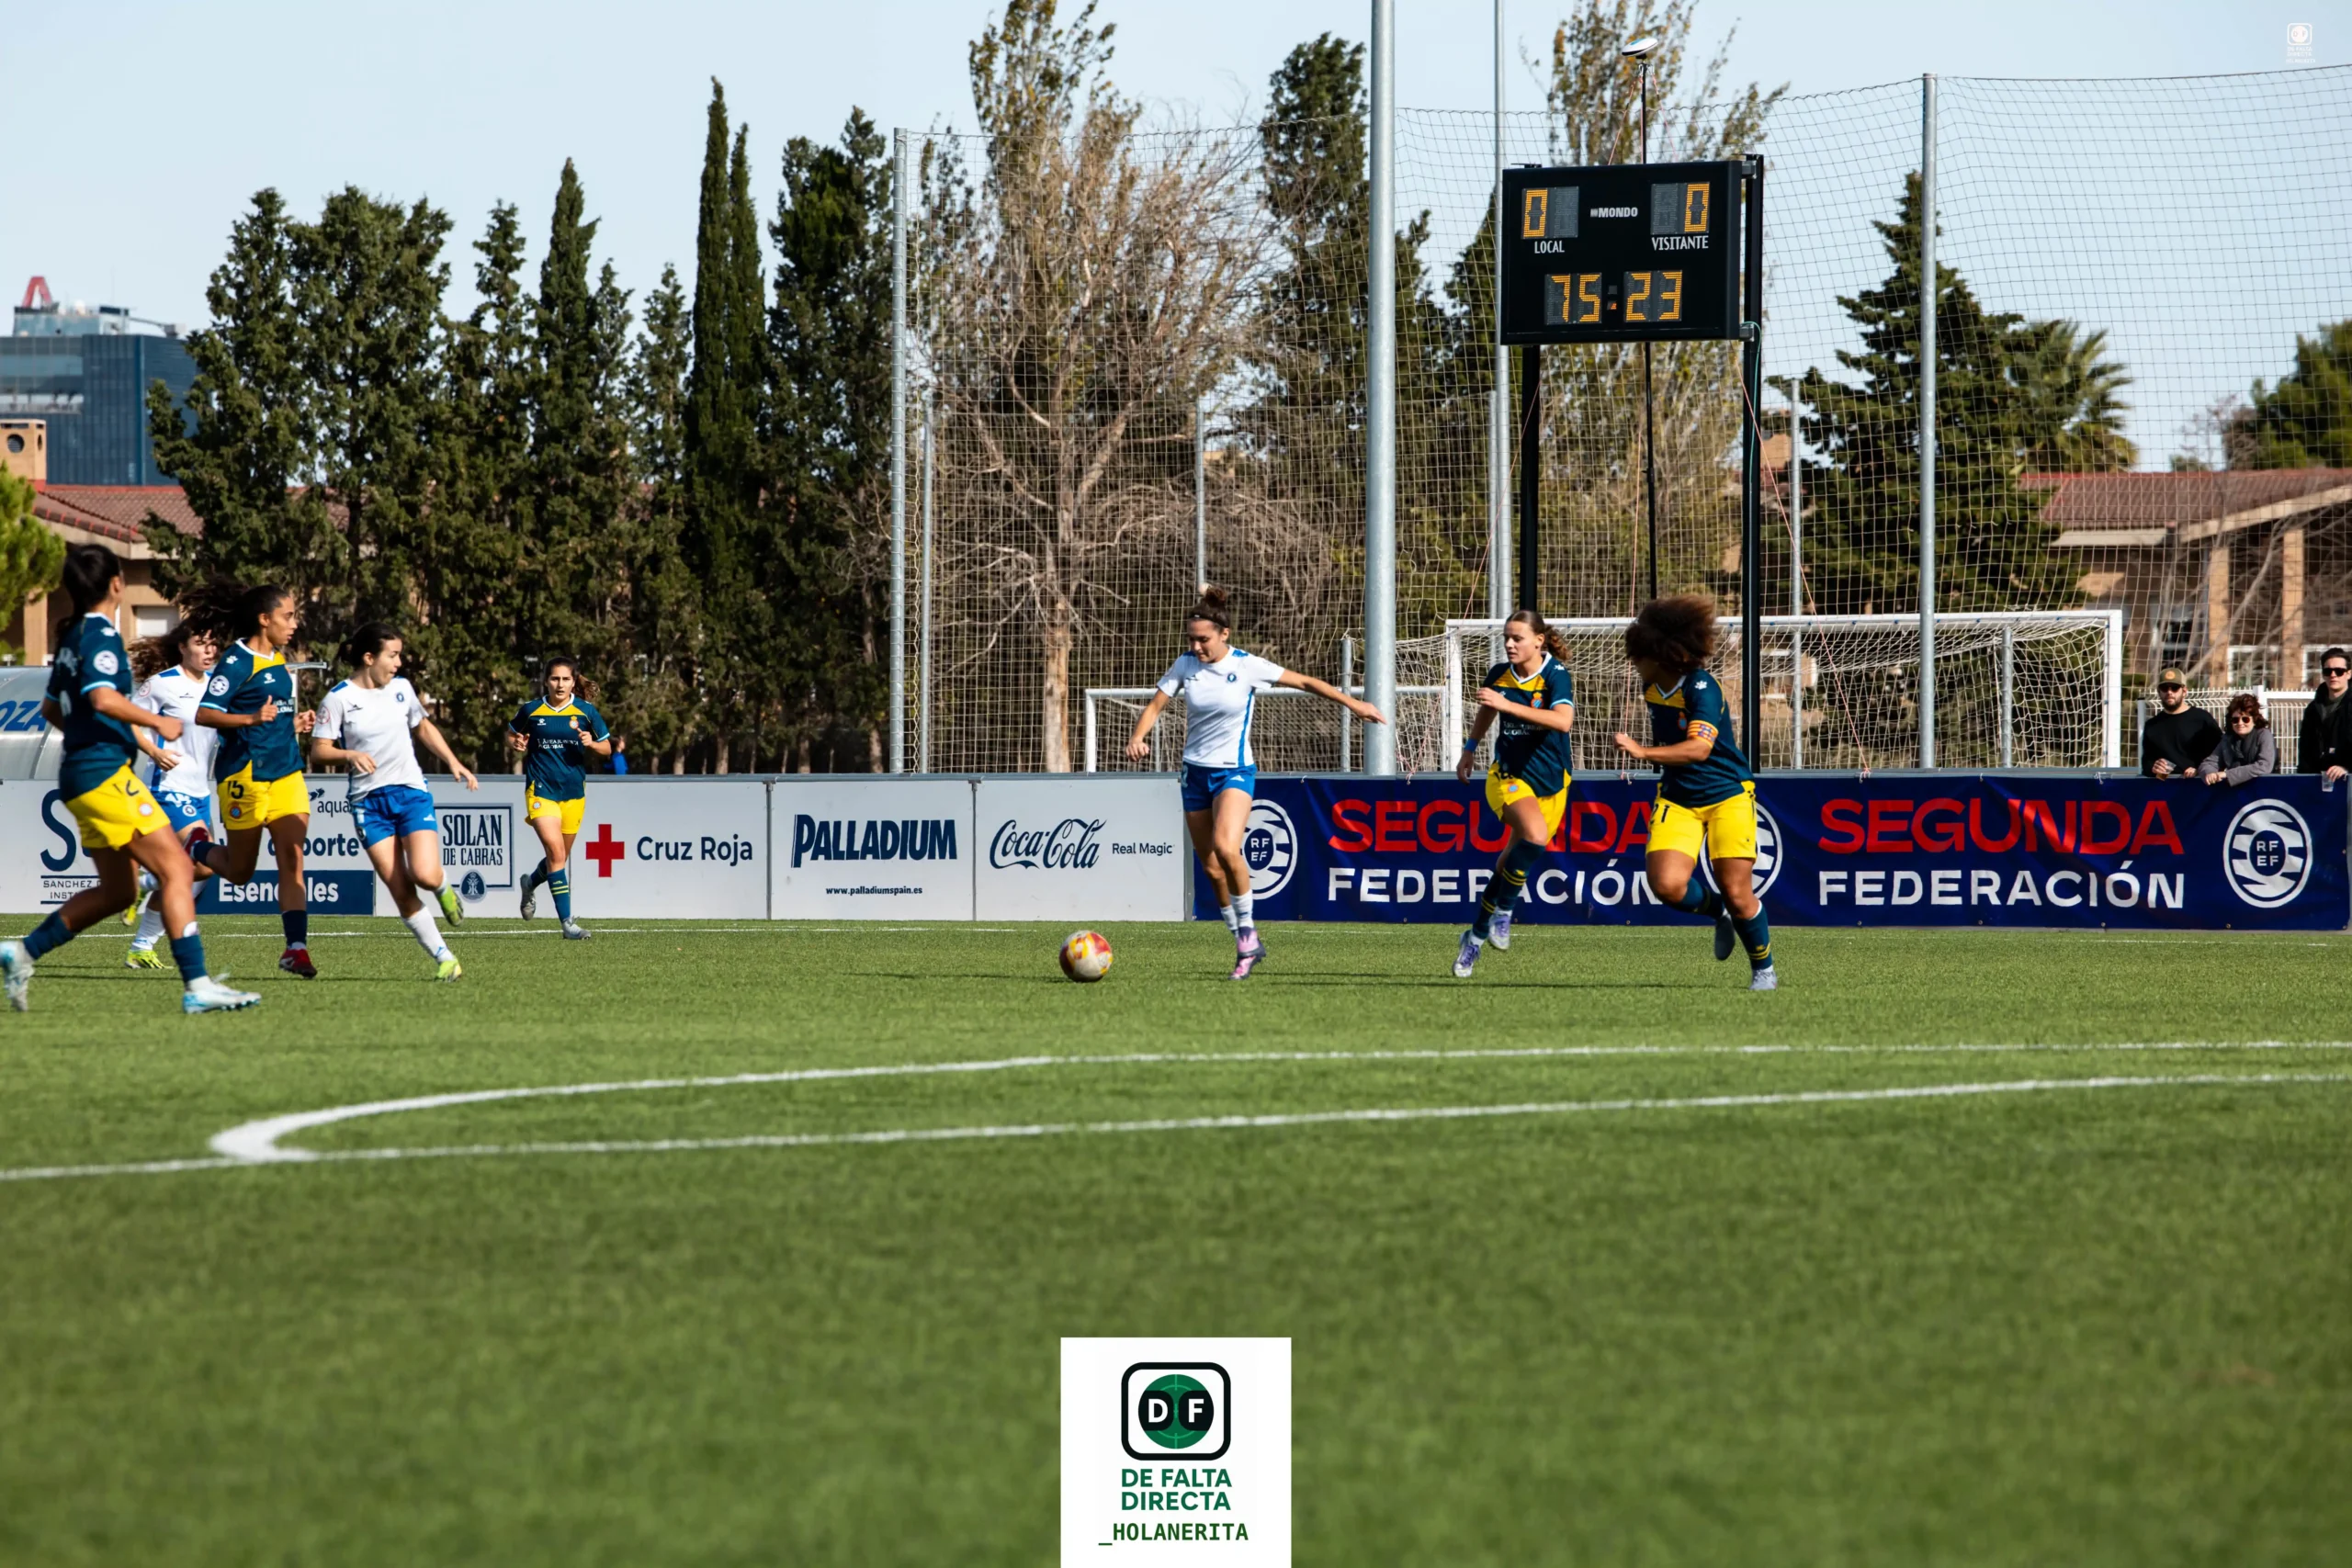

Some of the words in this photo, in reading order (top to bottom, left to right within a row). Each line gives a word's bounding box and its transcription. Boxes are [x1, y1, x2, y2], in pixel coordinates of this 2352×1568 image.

[1523, 189, 1548, 237] 0
[1599, 207, 1638, 218] MONDO
[1684, 184, 1710, 231] 0
[1534, 241, 1565, 254] LOCAL
[1651, 235, 1709, 251] VISITANTE
[790, 814, 957, 868] PALLADIUM
[1818, 798, 2185, 854] SEGUNDA
[443, 848, 456, 865] DE
[460, 848, 503, 865] CABRAS
[637, 836, 693, 861] Cruz
[701, 834, 752, 866] Roja
[989, 818, 1107, 870] Coca-Cola
[1113, 842, 1136, 854] Real
[1139, 842, 1173, 856] Magic
[43, 880, 92, 888] SANCHEZ
[826, 886, 922, 897] www.palladiumspain.es
[1819, 861, 2185, 908] FEDERACIÓN
